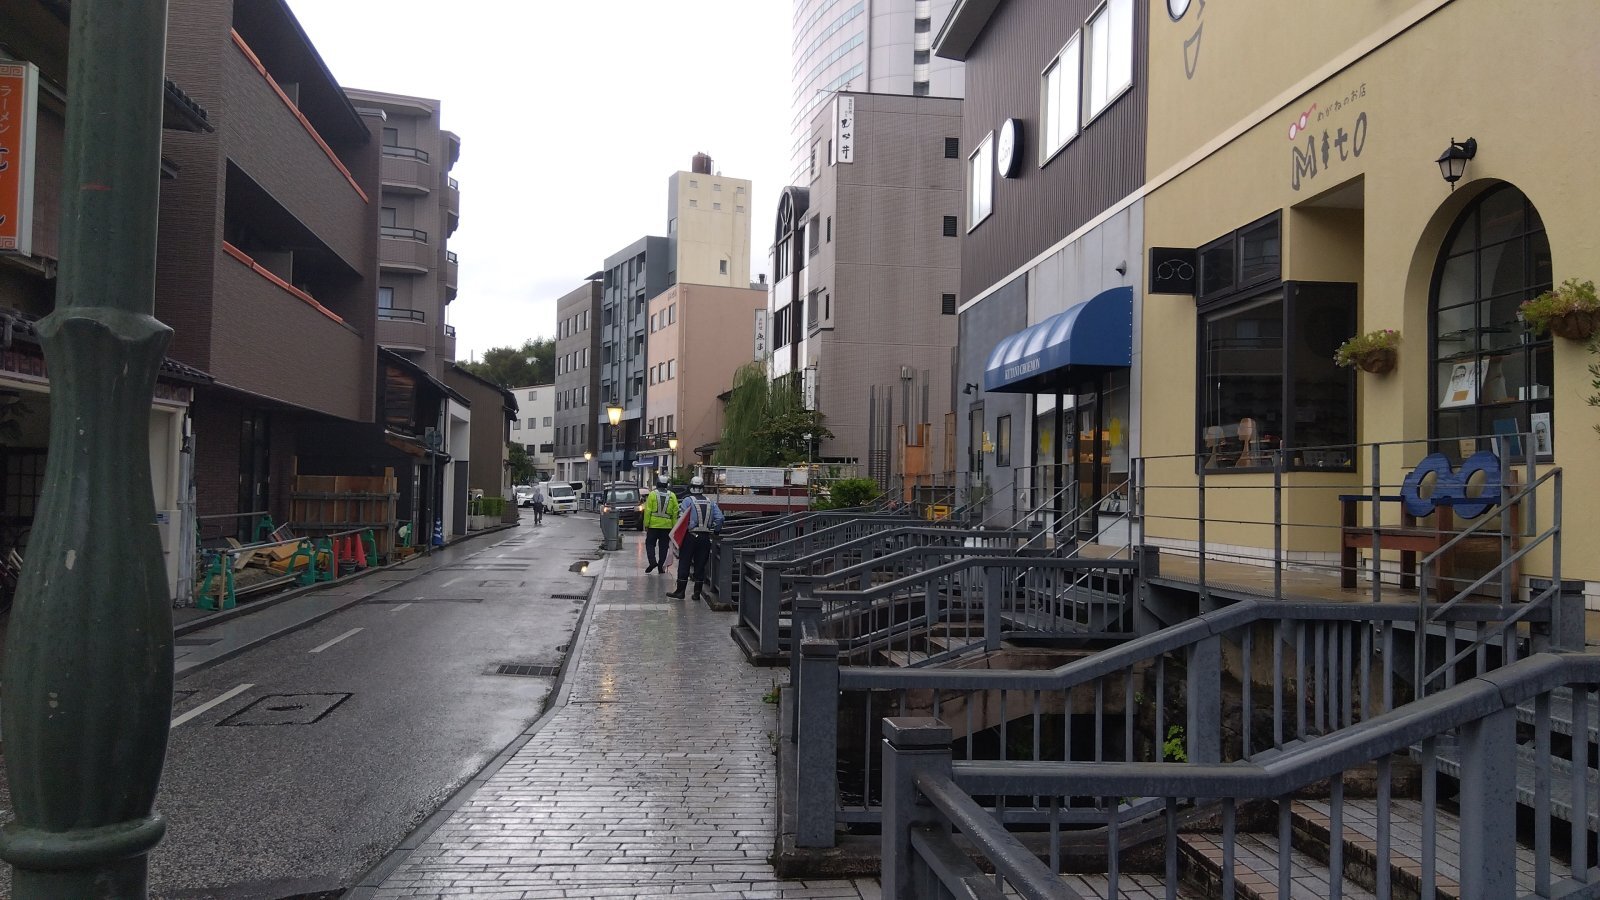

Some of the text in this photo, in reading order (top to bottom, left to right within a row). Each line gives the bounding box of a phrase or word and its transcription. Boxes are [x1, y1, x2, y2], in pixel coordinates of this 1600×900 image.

[0, 85, 12, 134] ラーメン
[1317, 83, 1366, 122] めがねのお店
